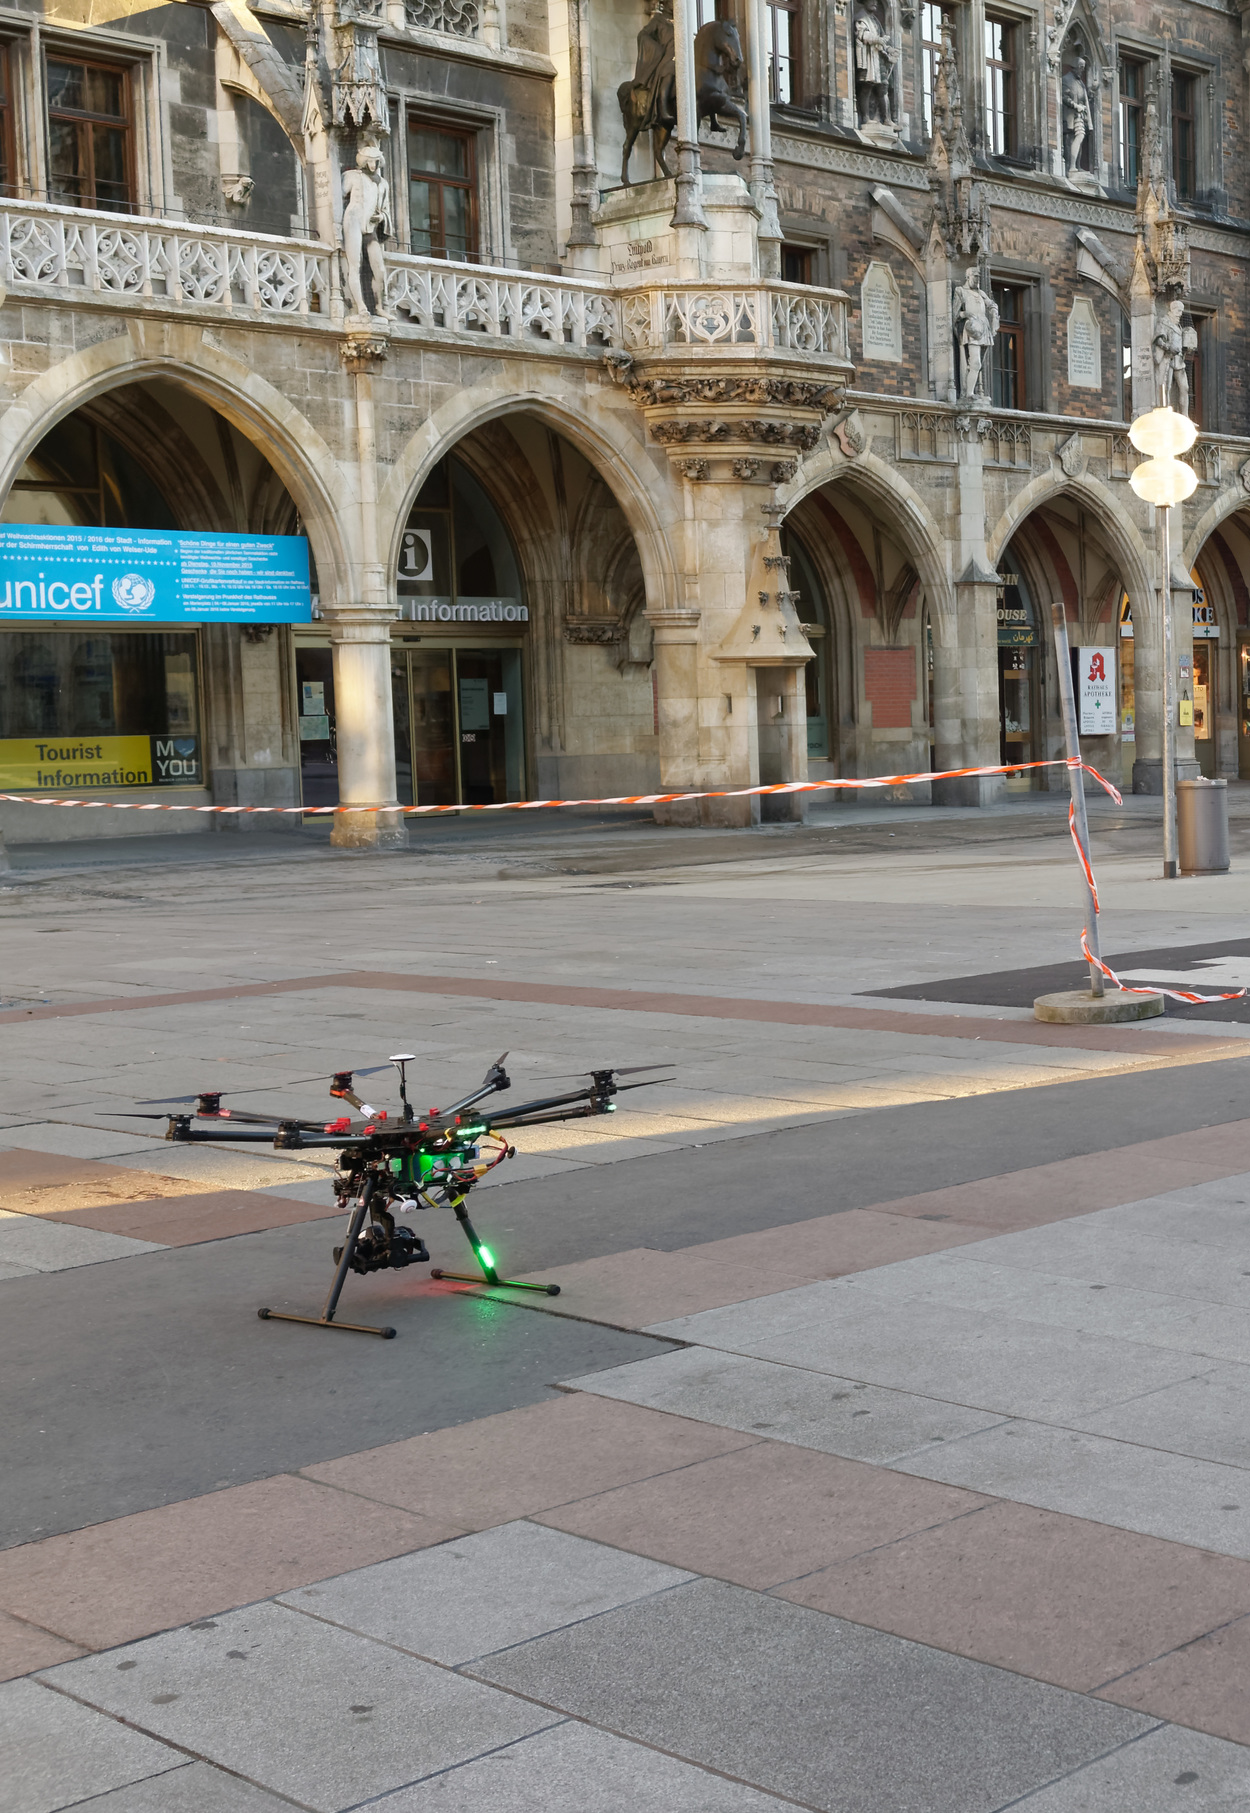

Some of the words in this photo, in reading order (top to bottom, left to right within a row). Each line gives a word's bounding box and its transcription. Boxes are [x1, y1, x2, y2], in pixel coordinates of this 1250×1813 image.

[19, 542, 73, 550] Schirmherrschaft
[0, 573, 104, 610] unicef
[411, 599, 529, 622] Information
[997, 609, 1027, 620] OUSE
[35, 743, 102, 761] Tourist
[156, 740, 174, 757] M
[156, 760, 196, 776] YOU
[37, 768, 148, 787] Information
